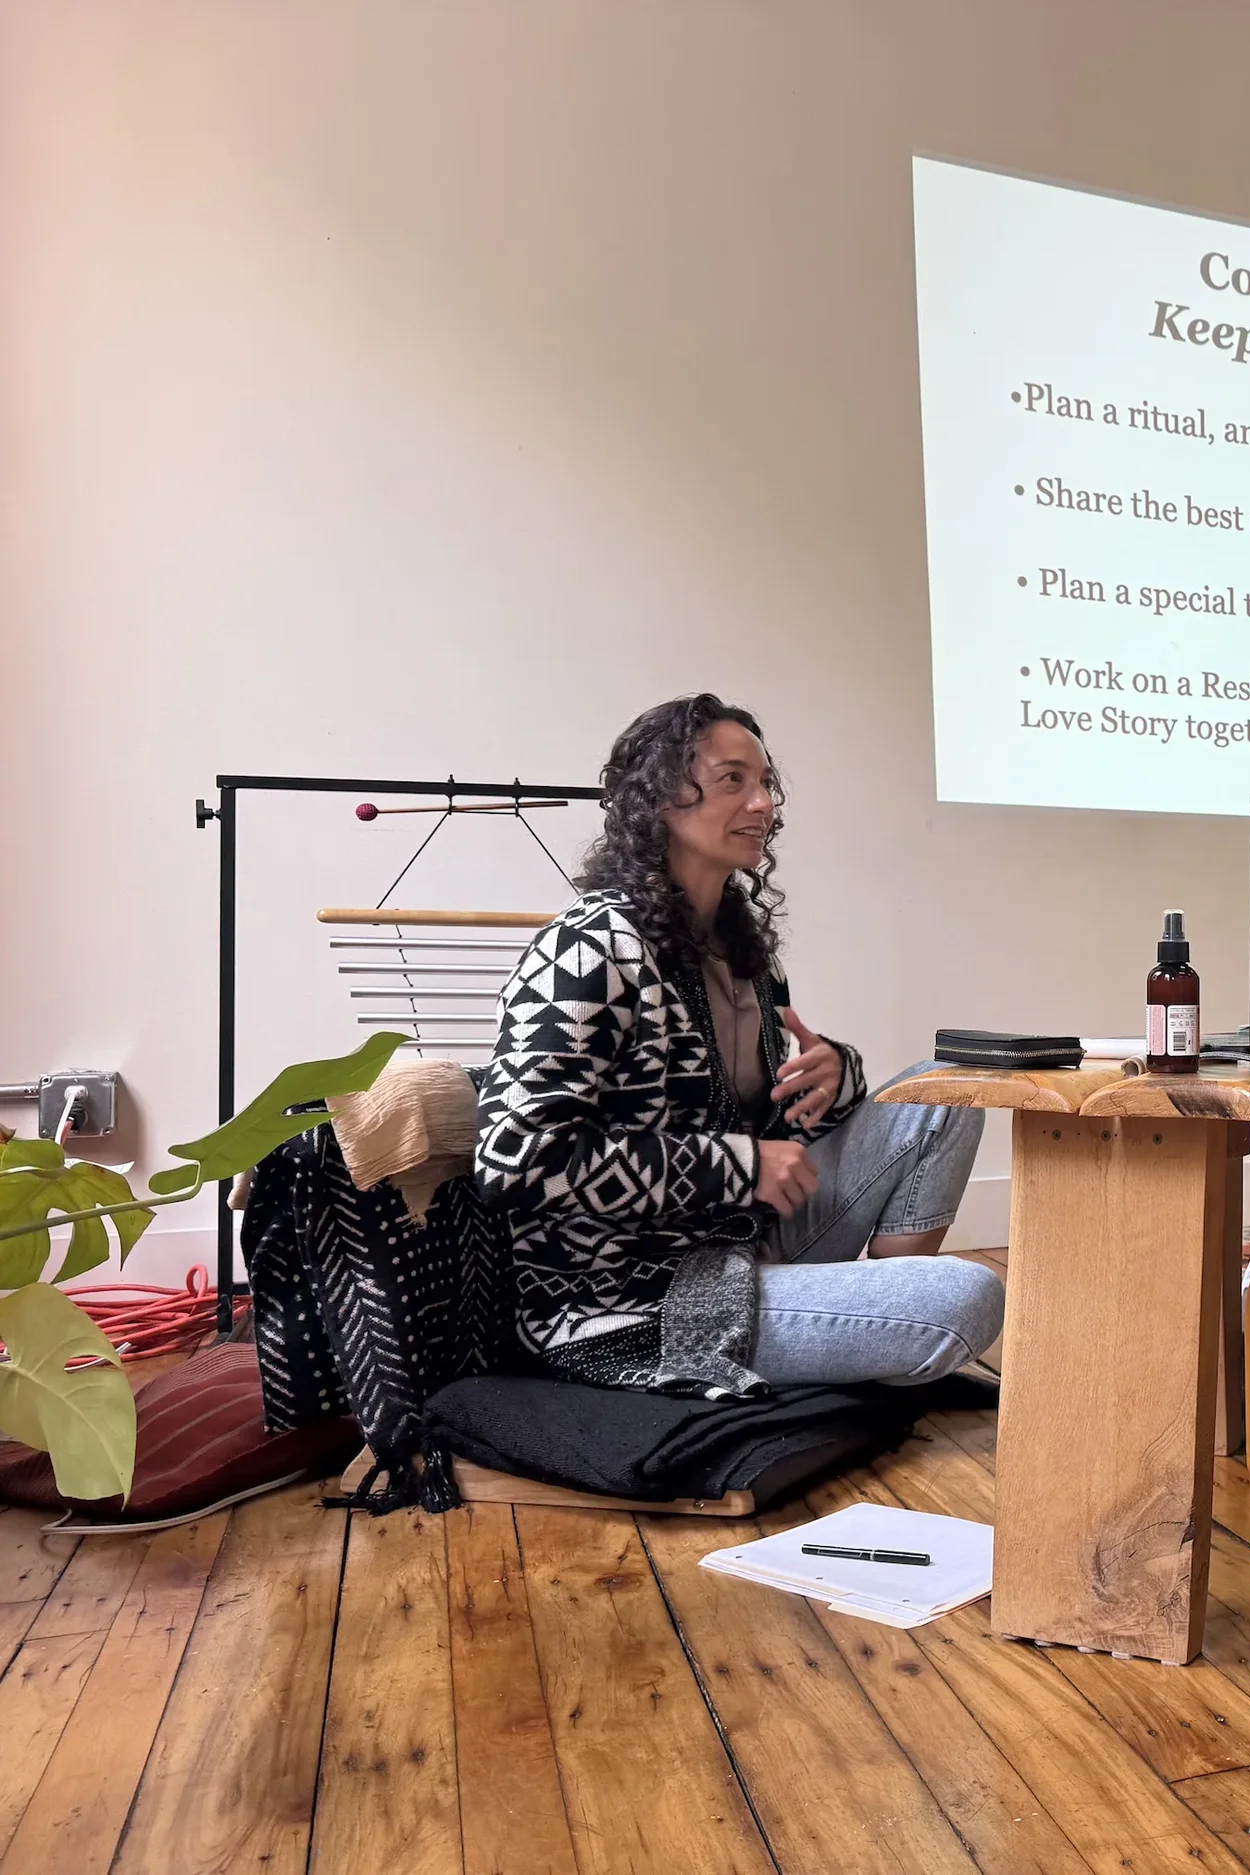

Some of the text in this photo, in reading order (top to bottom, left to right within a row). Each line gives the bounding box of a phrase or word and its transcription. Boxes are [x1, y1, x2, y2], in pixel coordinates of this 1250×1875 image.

[1102, 403, 1120, 426] a
[1127, 399, 1215, 446] ritual,
[1035, 476, 1124, 516] Share
[1129, 489, 1178, 523] the
[1183, 494, 1245, 532] best
[1038, 567, 1107, 603] Plan
[1115, 584, 1132, 606] a
[1139, 584, 1237, 617] special
[1039, 657, 1125, 691] Work
[1131, 672, 1169, 695] on
[1177, 676, 1193, 697] a
[1019, 699, 1093, 732] Love
[1100, 705, 1179, 745] Story
